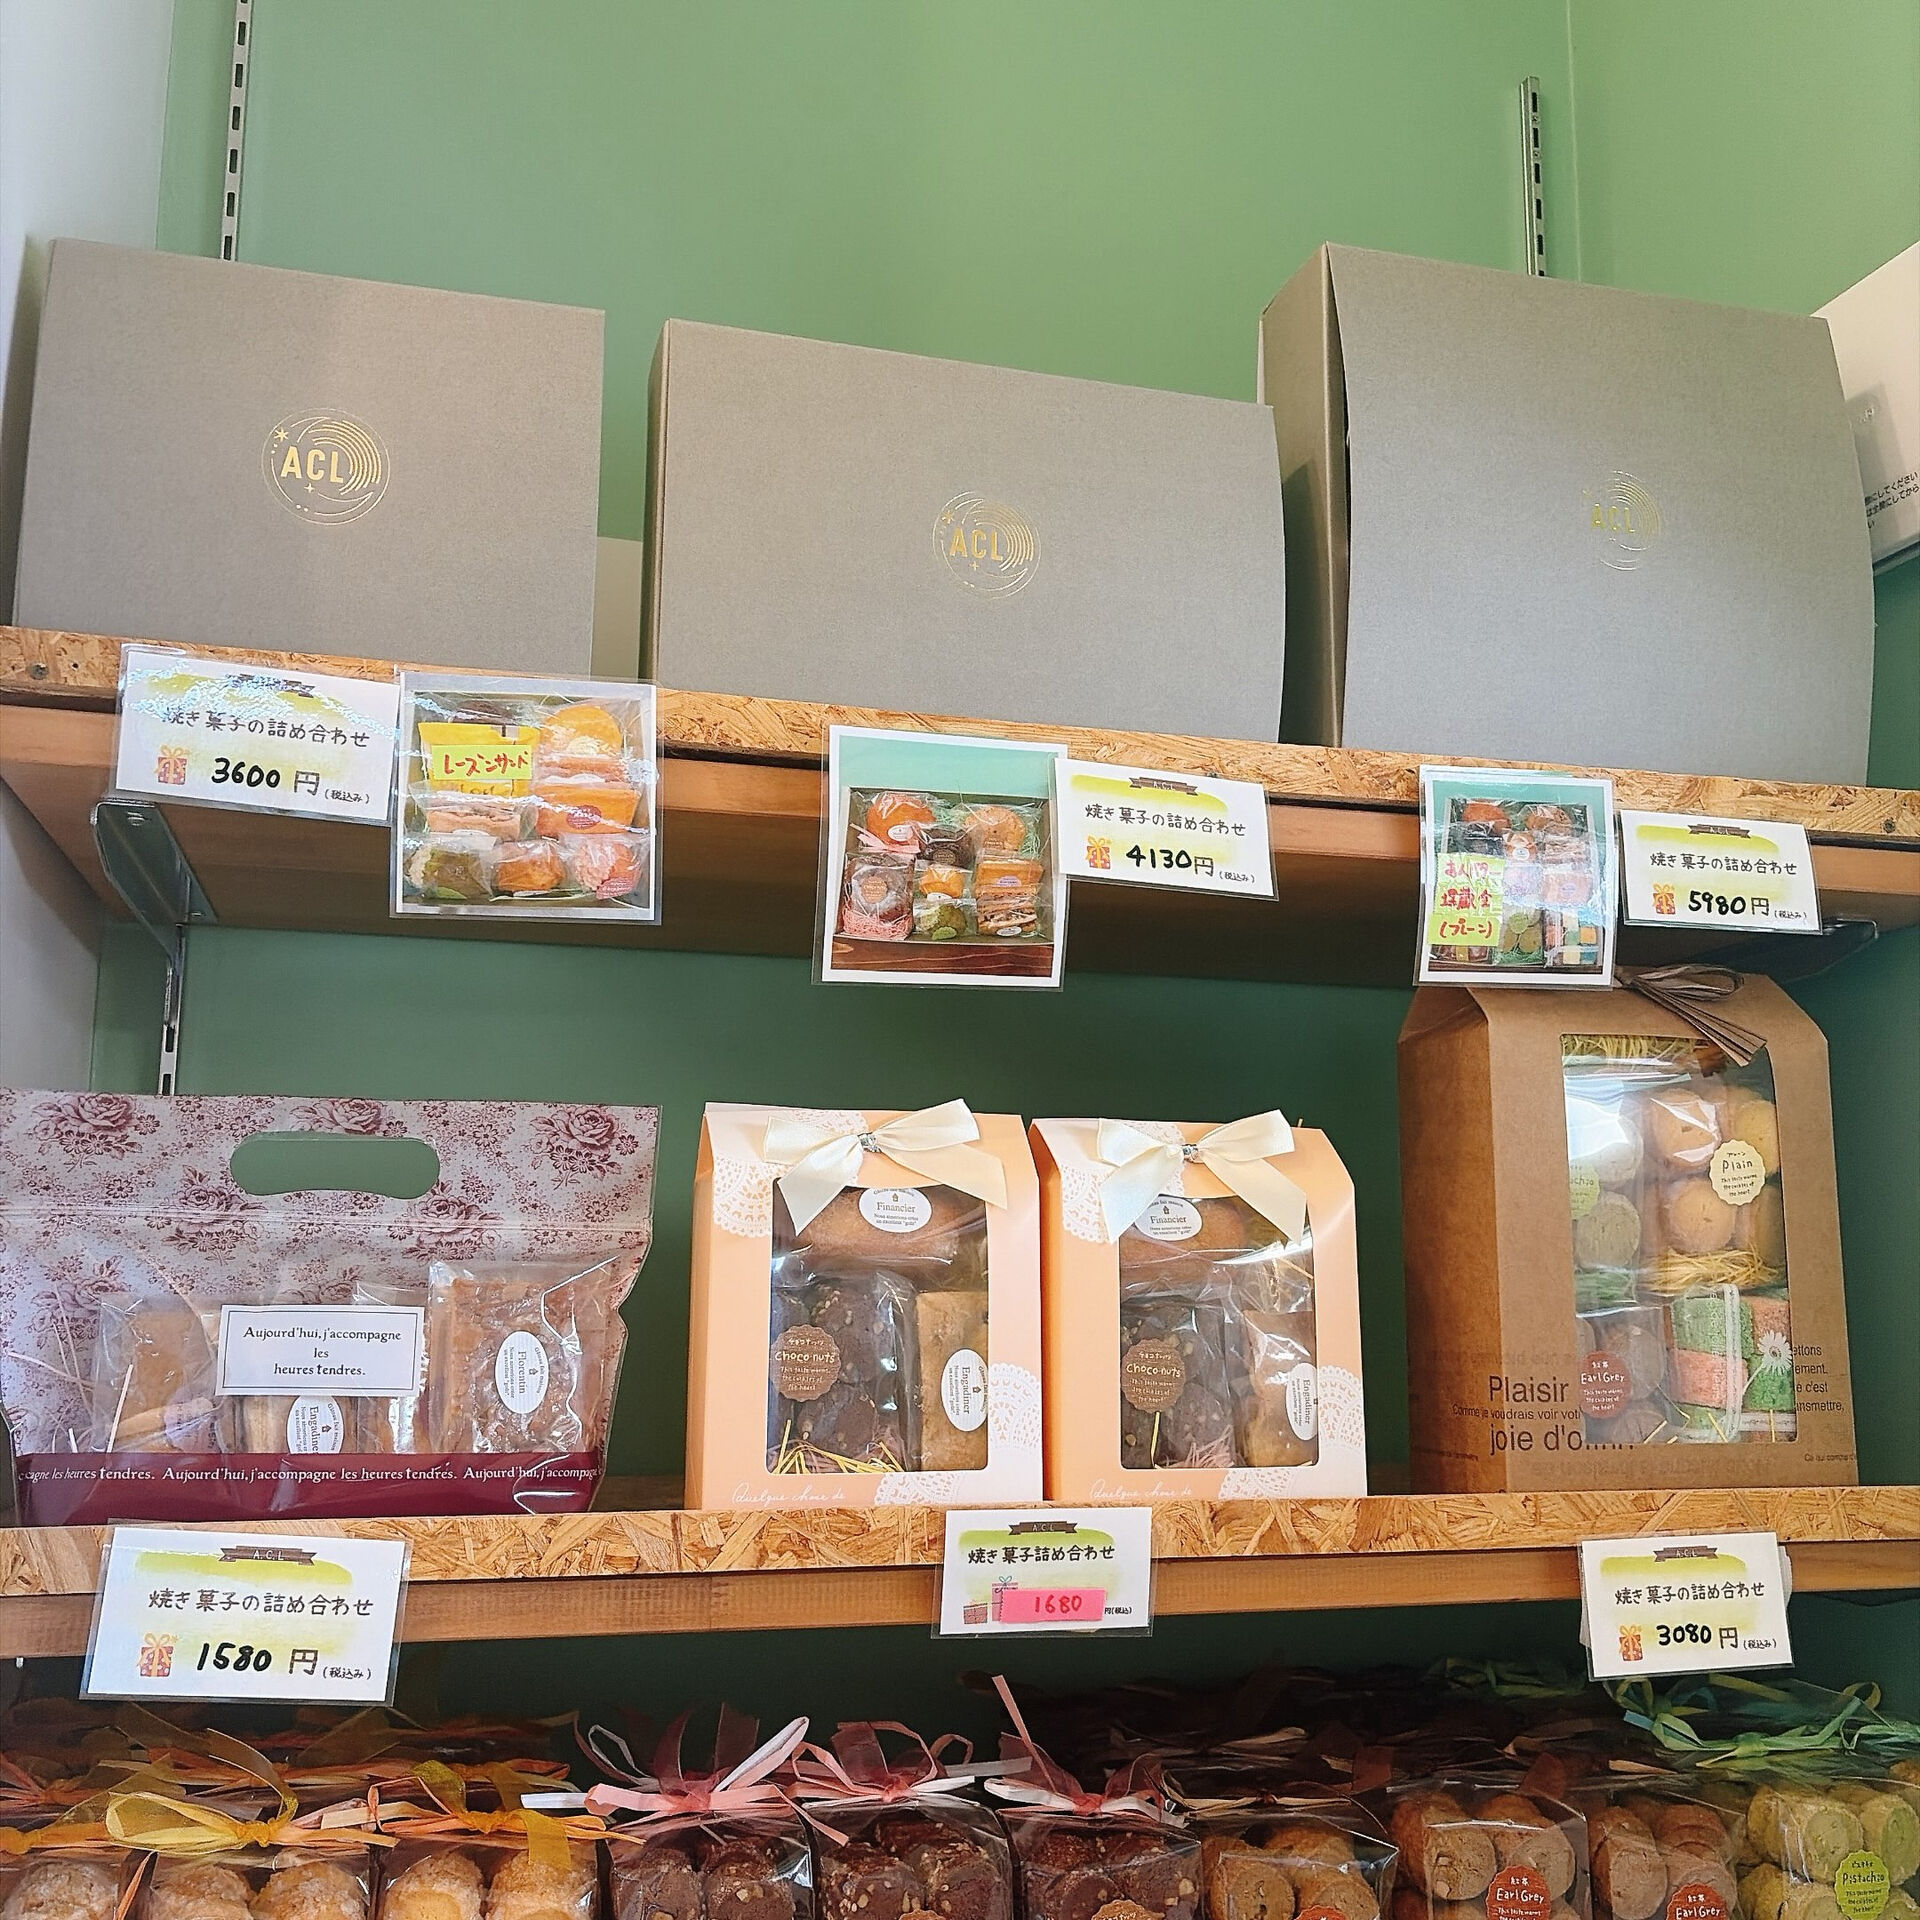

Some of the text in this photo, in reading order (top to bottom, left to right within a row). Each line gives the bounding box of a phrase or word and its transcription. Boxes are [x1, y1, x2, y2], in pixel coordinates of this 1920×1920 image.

[279, 445, 344, 484] ACL
[1591, 502, 1635, 534] ACL
[949, 527, 1004, 561] ACL
[211, 757, 281, 789] 3600
[293, 770, 320, 796] 円
[1084, 803, 1247, 837] 焼き菓子の詰め合わせ
[1649, 851, 1798, 876] 焼き菓子の詰め合わせ
[1722, 1160, 1753, 1174] Plain
[876, 1202, 916, 1213] Financier
[1150, 1214, 1187, 1224] Financier
[243, 1326, 402, 1343] Aujourd'hui, j'accompagne
[313, 1348, 330, 1358] les
[274, 1363, 366, 1376] heures tendres.
[518, 1350, 528, 1394] Florentin
[1581, 1371, 1625, 1385] Earl Grey
[960, 1366, 972, 1415] Engadiner
[1488, 1375, 1570, 1403] Plaisir
[1302, 1379, 1312, 1425] Engadiner
[1490, 1408, 1534, 1420] voudrais
[1537, 1409, 1558, 1420] voir
[308, 1406, 320, 1452] Engadine
[1490, 1423, 1534, 1456] joie
[64, 1467, 96, 1480] heures
[100, 1466, 156, 1480] tendres.
[162, 1468, 248, 1483] Aujourd'hui,
[250, 1468, 336, 1484] j'accompagne
[340, 1468, 358, 1480] les
[361, 1468, 404, 1480] heures
[406, 1466, 457, 1480] tendres.
[968, 1544, 1116, 1565] 焼き菓子詰め合わせ
[148, 1588, 374, 1618] 焼き菓子の詰め合わせ
[1034, 1594, 1083, 1614] 1680
[1614, 1581, 1766, 1606] 焼き菓子の詰め合わせ
[1656, 1623, 1712, 1646] 3080
[196, 1642, 272, 1672] 1580
[288, 1648, 319, 1676] 円
[1842, 1870, 1884, 1885] Pistachio
[1496, 1888, 1544, 1904] Earl Grey
[1676, 1906, 1720, 1920] Earl Grey
